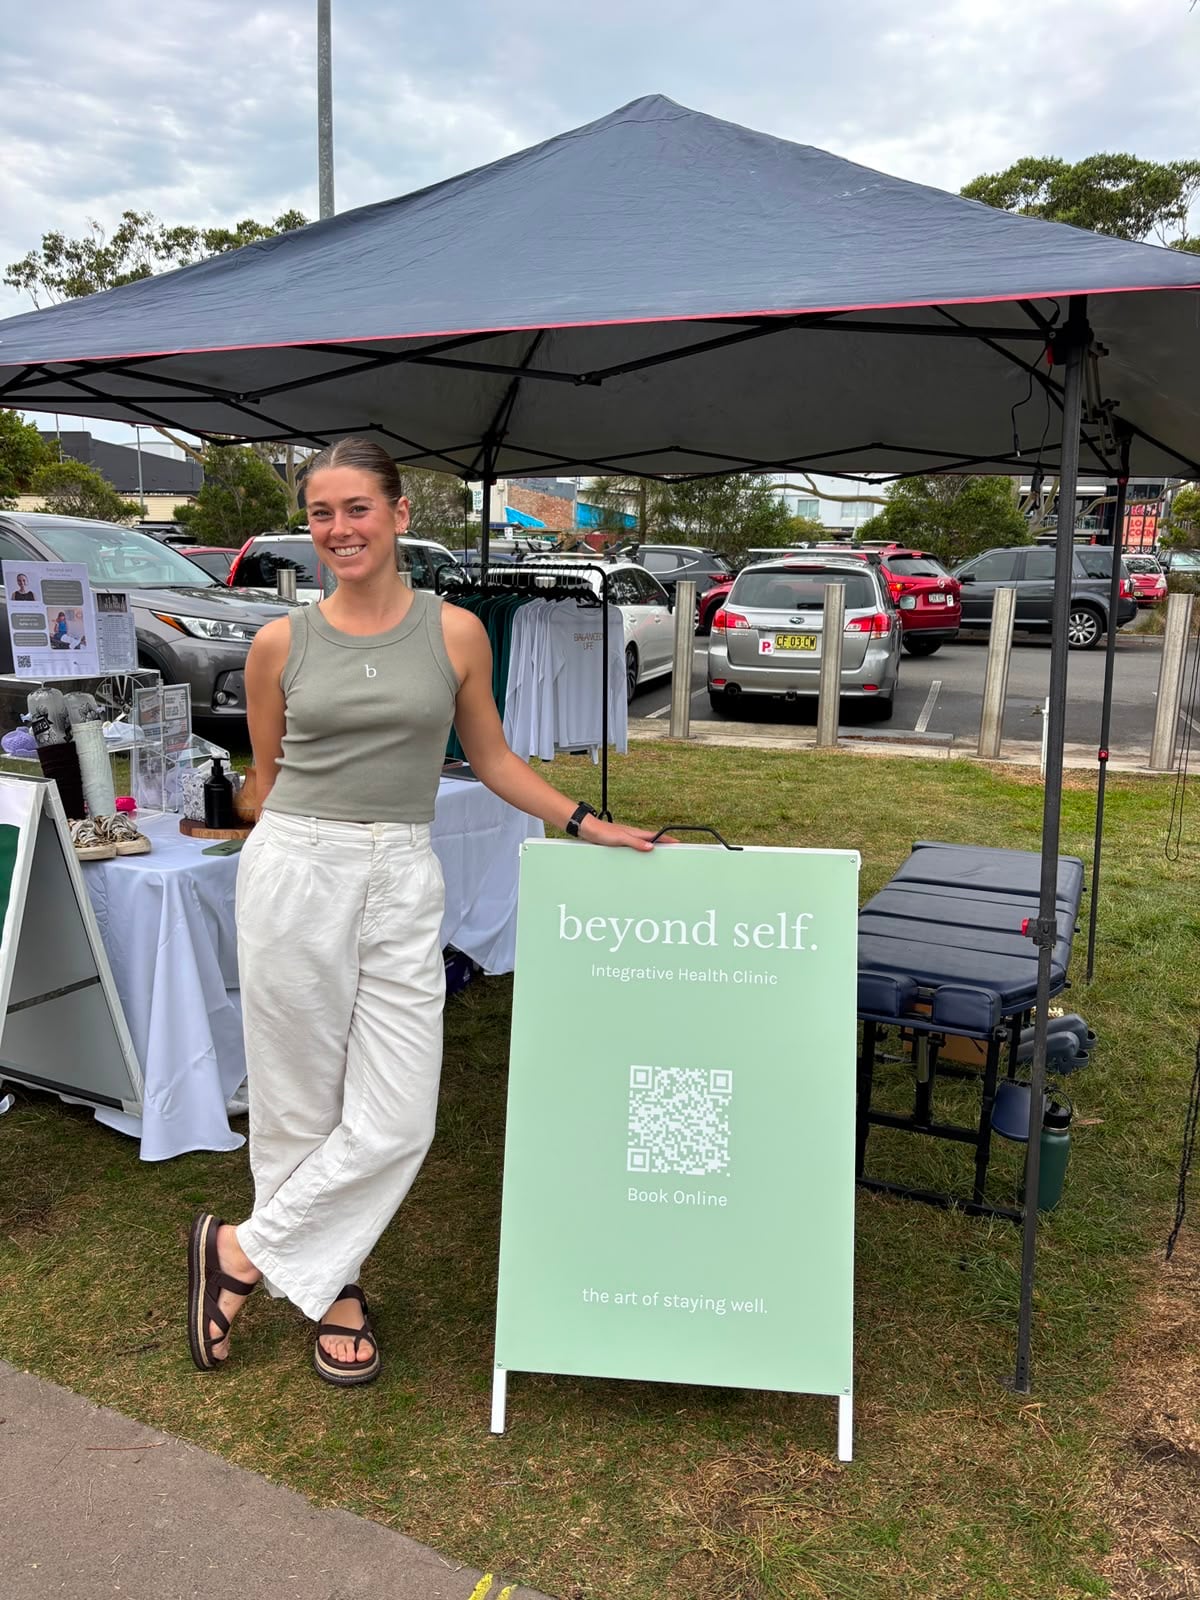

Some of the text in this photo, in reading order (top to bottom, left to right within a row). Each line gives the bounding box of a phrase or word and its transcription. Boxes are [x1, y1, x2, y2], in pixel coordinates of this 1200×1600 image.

[762, 641, 771, 653] P
[776, 636, 788, 646] CF
[364, 664, 377, 678] b
[557, 903, 819, 953] beyond self.
[591, 963, 778, 985] Integrative Health Clinic
[627, 1187, 728, 1207] Book Online
[582, 1288, 769, 1316] the art of staying well.
